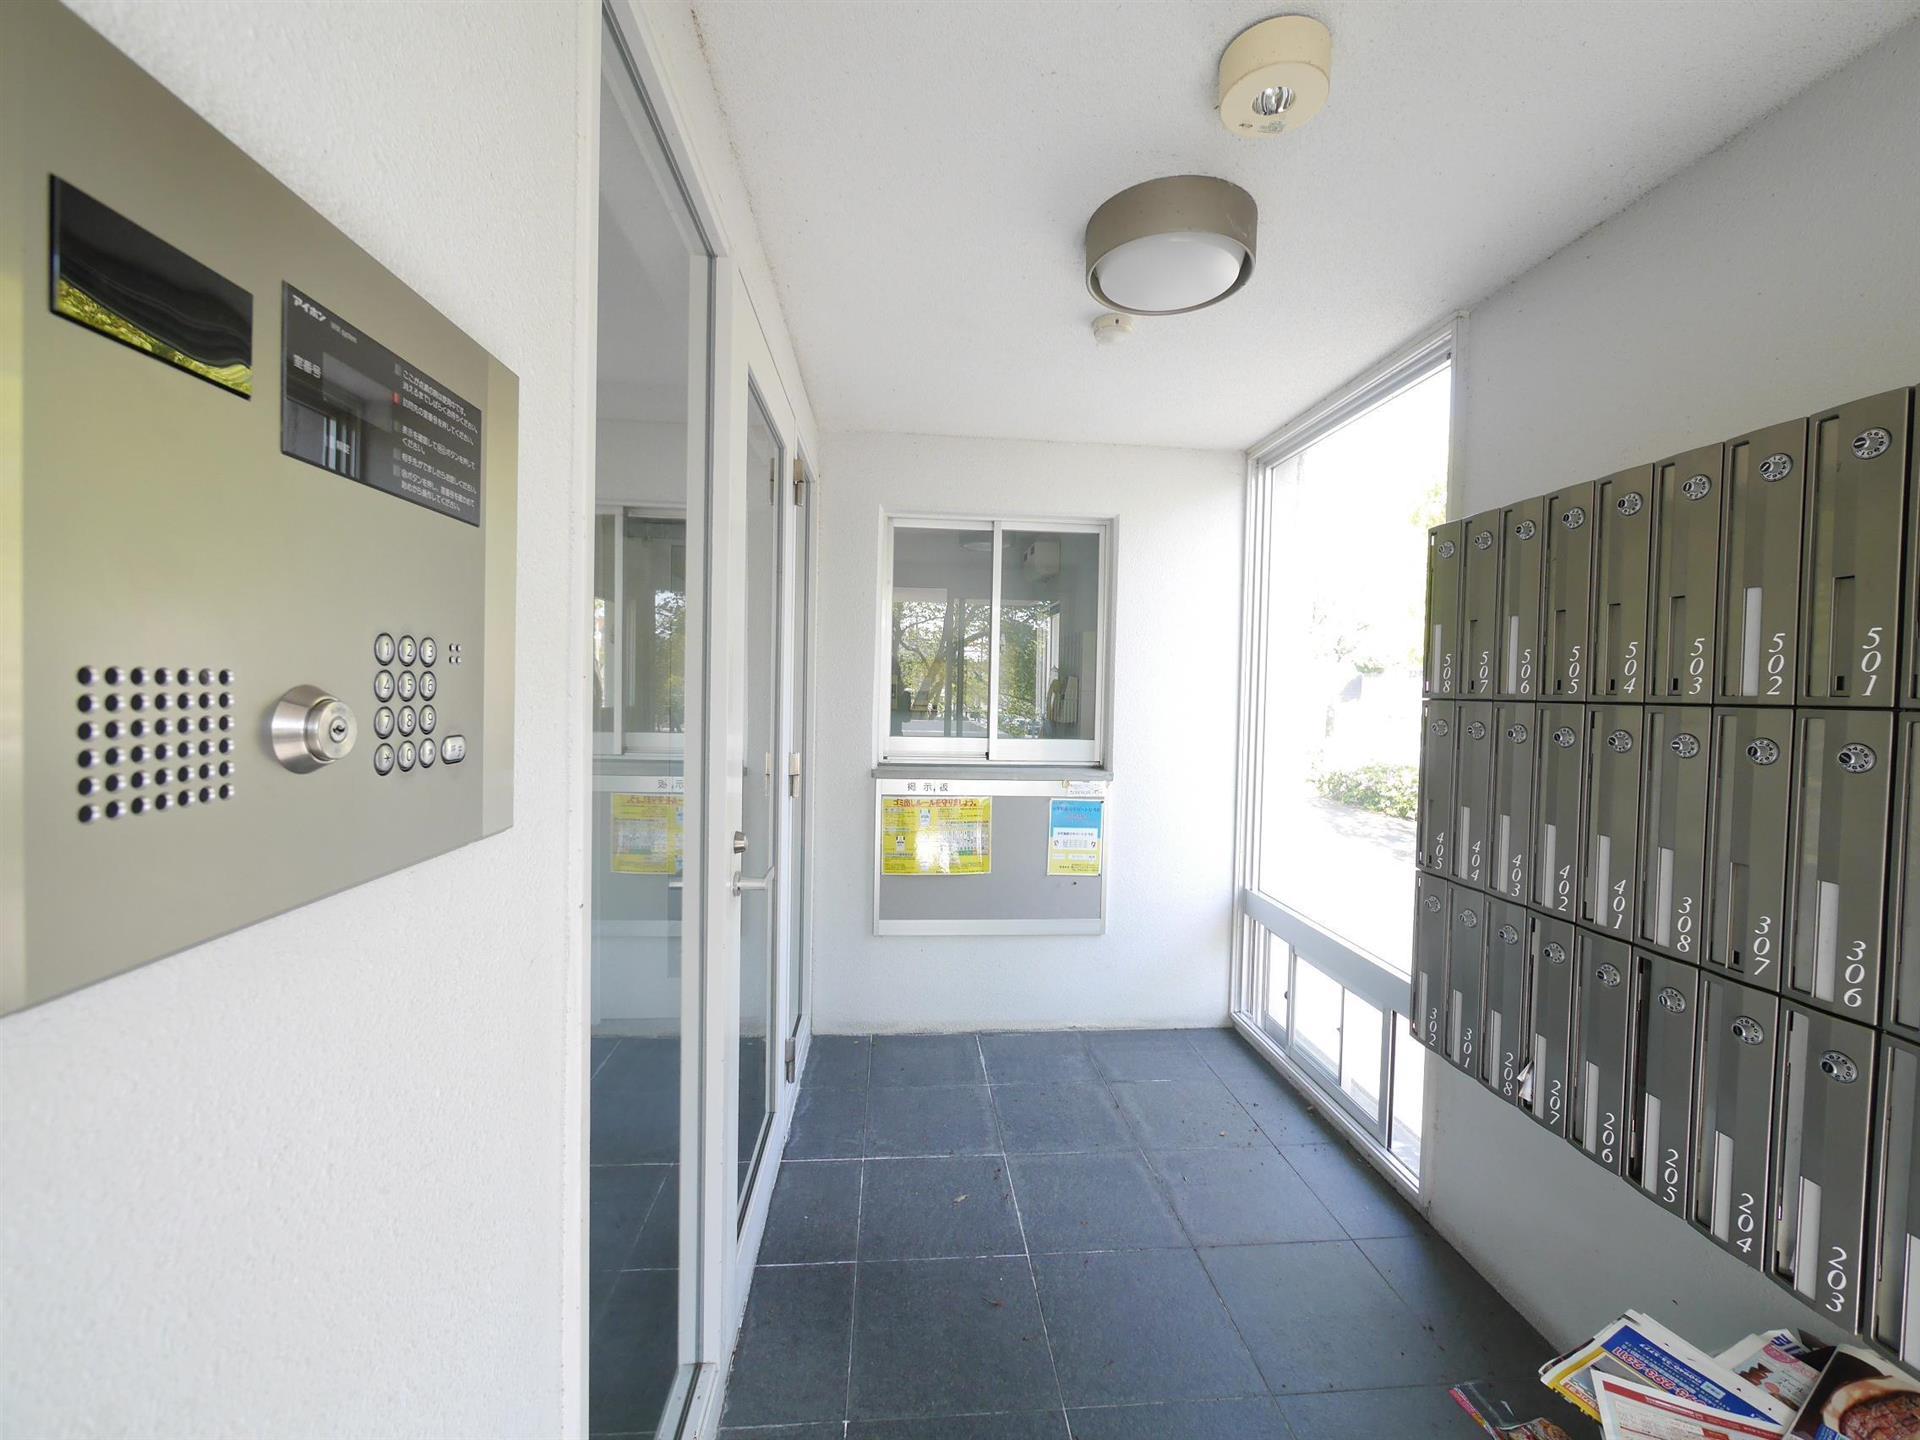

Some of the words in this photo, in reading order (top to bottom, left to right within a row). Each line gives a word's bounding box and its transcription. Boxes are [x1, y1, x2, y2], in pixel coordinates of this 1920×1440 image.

[292, 294, 326, 322] アイホン
[293, 353, 321, 379] 室番号
[1442, 653, 1452, 693] 508
[1479, 651, 1489, 693] 507
[1520, 648, 1531, 694] 506
[1567, 645, 1581, 694] 505
[1623, 641, 1638, 694] 504
[1688, 637, 1706, 695] 503
[1766, 632, 1786, 695] 502
[1861, 627, 1883, 696] 501
[1434, 832, 1445, 870] 405
[1470, 840, 1481, 881] 404
[1511, 854, 1522, 897] 403
[1557, 864, 1571, 912] 402
[1612, 879, 1627, 929] 401
[1676, 896, 1693, 953] 308
[1753, 915, 1771, 976] 307
[1843, 940, 1867, 1008] 306
[1428, 1007, 1438, 1047] 302
[1463, 1027, 1473, 1068] 301
[1503, 1051, 1514, 1096] 208
[1549, 1079, 1561, 1125] 207
[1601, 1112, 1615, 1163] 206
[1663, 1148, 1679, 1203] 205
[1736, 1192, 1754, 1253] 204
[1825, 1246, 1848, 1313] 203
